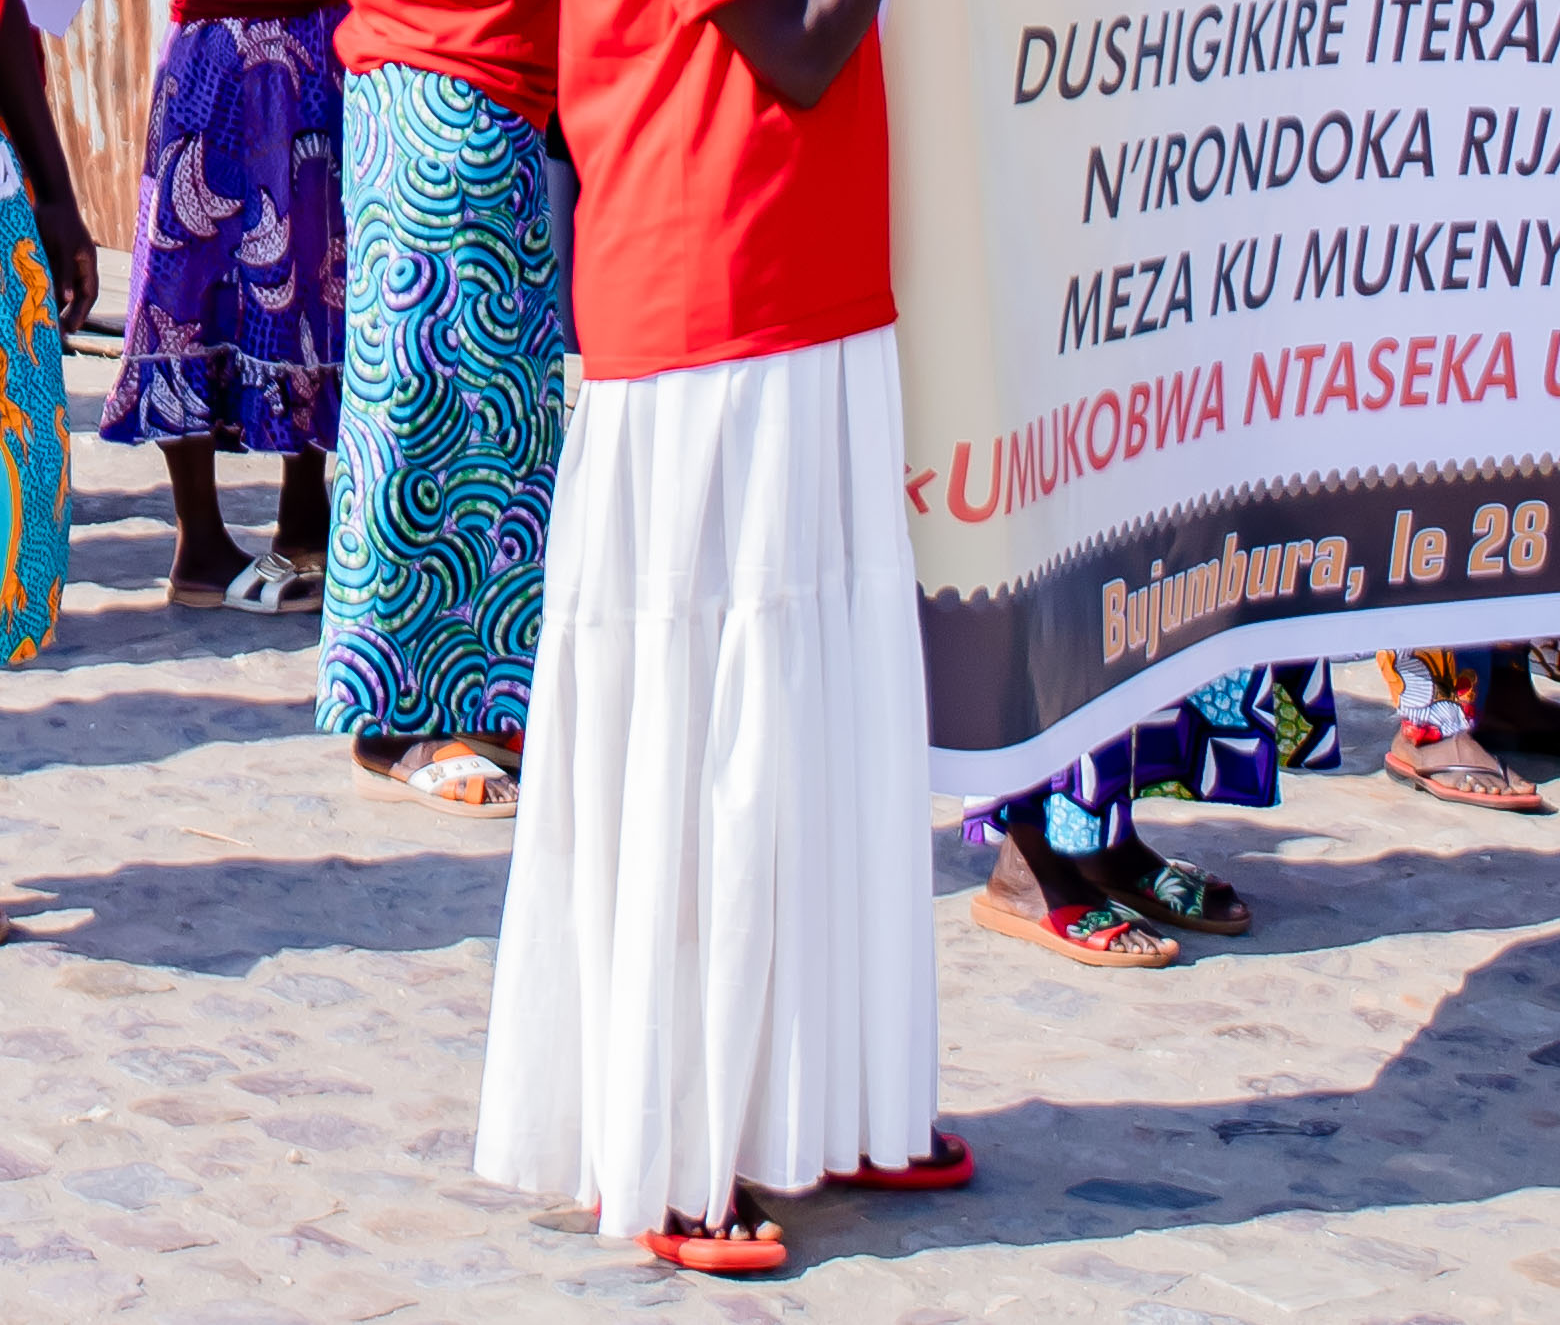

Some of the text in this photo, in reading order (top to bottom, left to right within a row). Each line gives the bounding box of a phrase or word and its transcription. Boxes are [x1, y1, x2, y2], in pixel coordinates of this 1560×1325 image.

[1081, 106, 1435, 225] N'IRONDOKA
[1057, 251, 1193, 356] MEZA
[1210, 232, 1283, 318] KU
[1243, 331, 1519, 427] NTASEKA
[1102, 532, 1365, 666] Bujumbura,
[1388, 509, 1446, 585] le
[1468, 499, 1550, 580] 28
